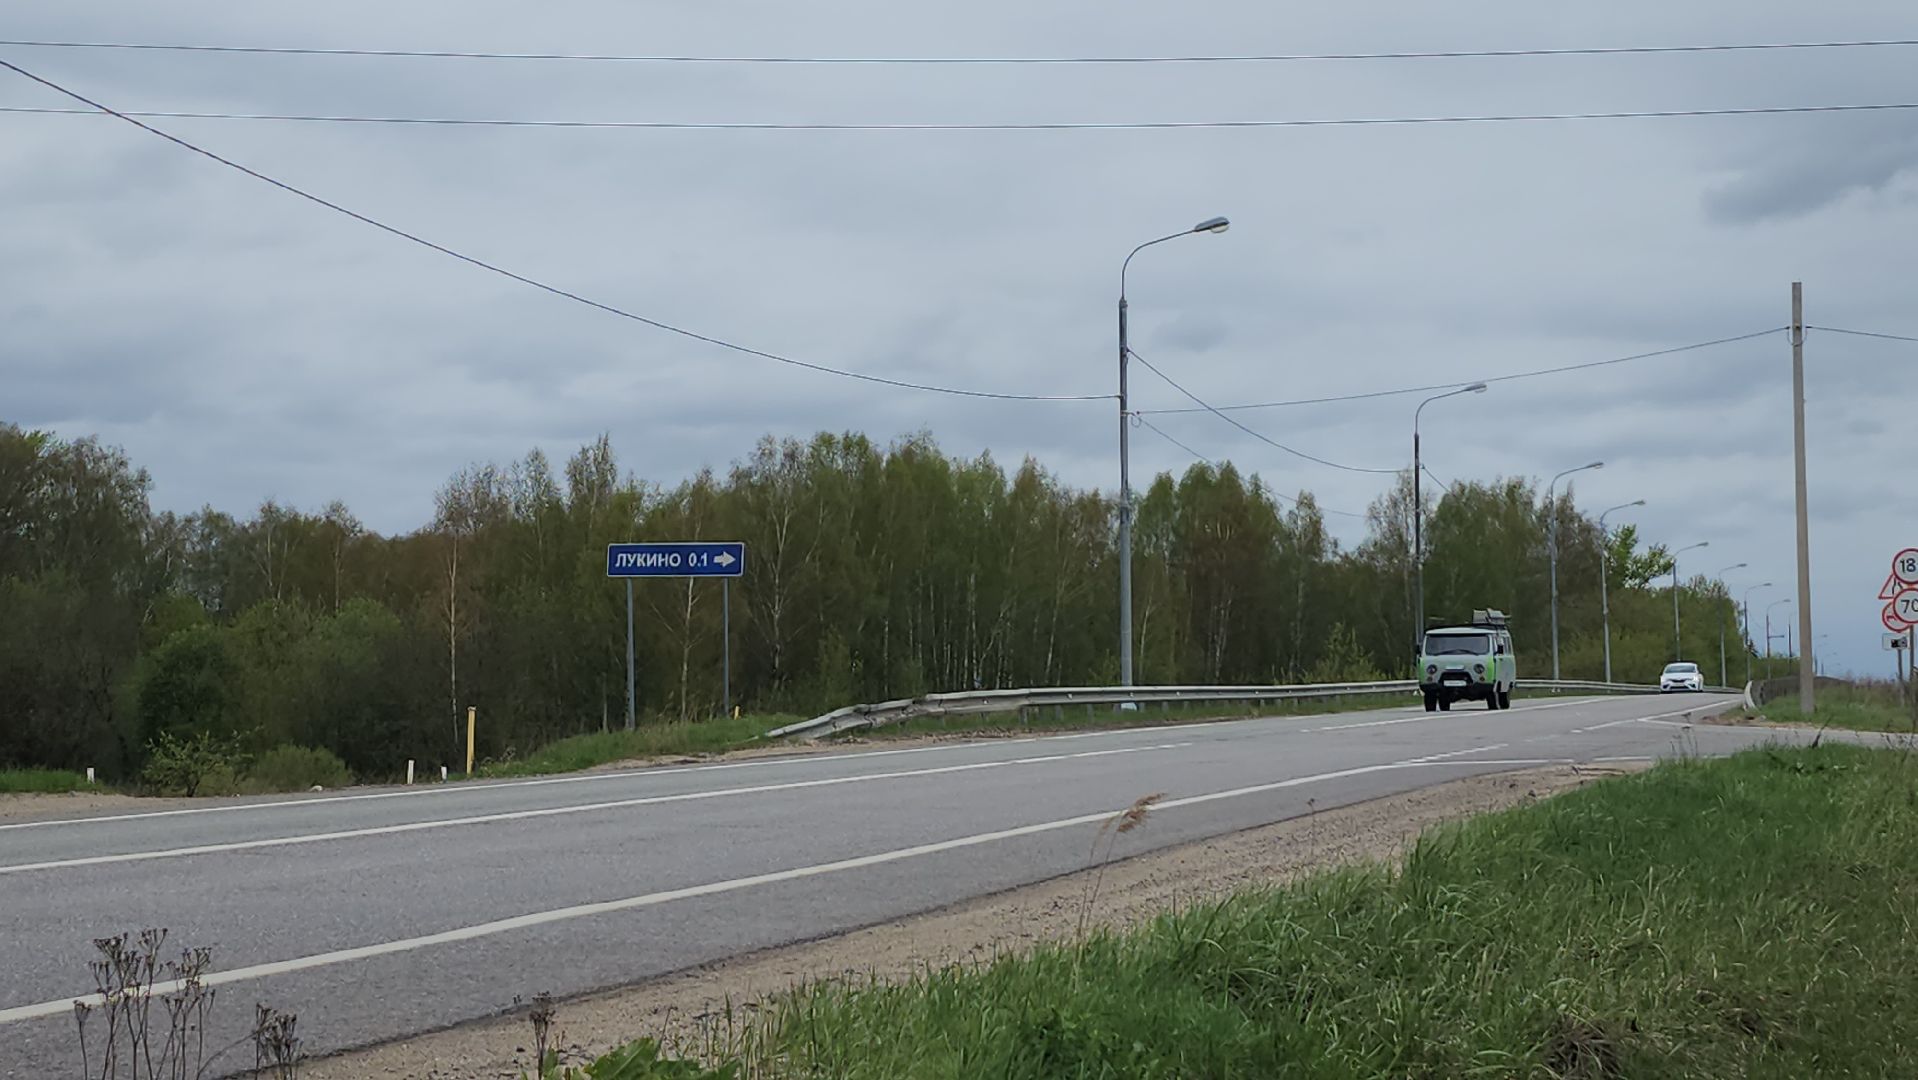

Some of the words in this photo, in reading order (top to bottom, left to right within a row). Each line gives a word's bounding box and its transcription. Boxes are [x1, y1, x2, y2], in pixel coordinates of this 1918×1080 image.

[615, 553, 682, 567] ЛУКИНО
[688, 552, 708, 567] 0.1
[1900, 558, 1918, 573] 18
[1900, 598, 1918, 613] 70
